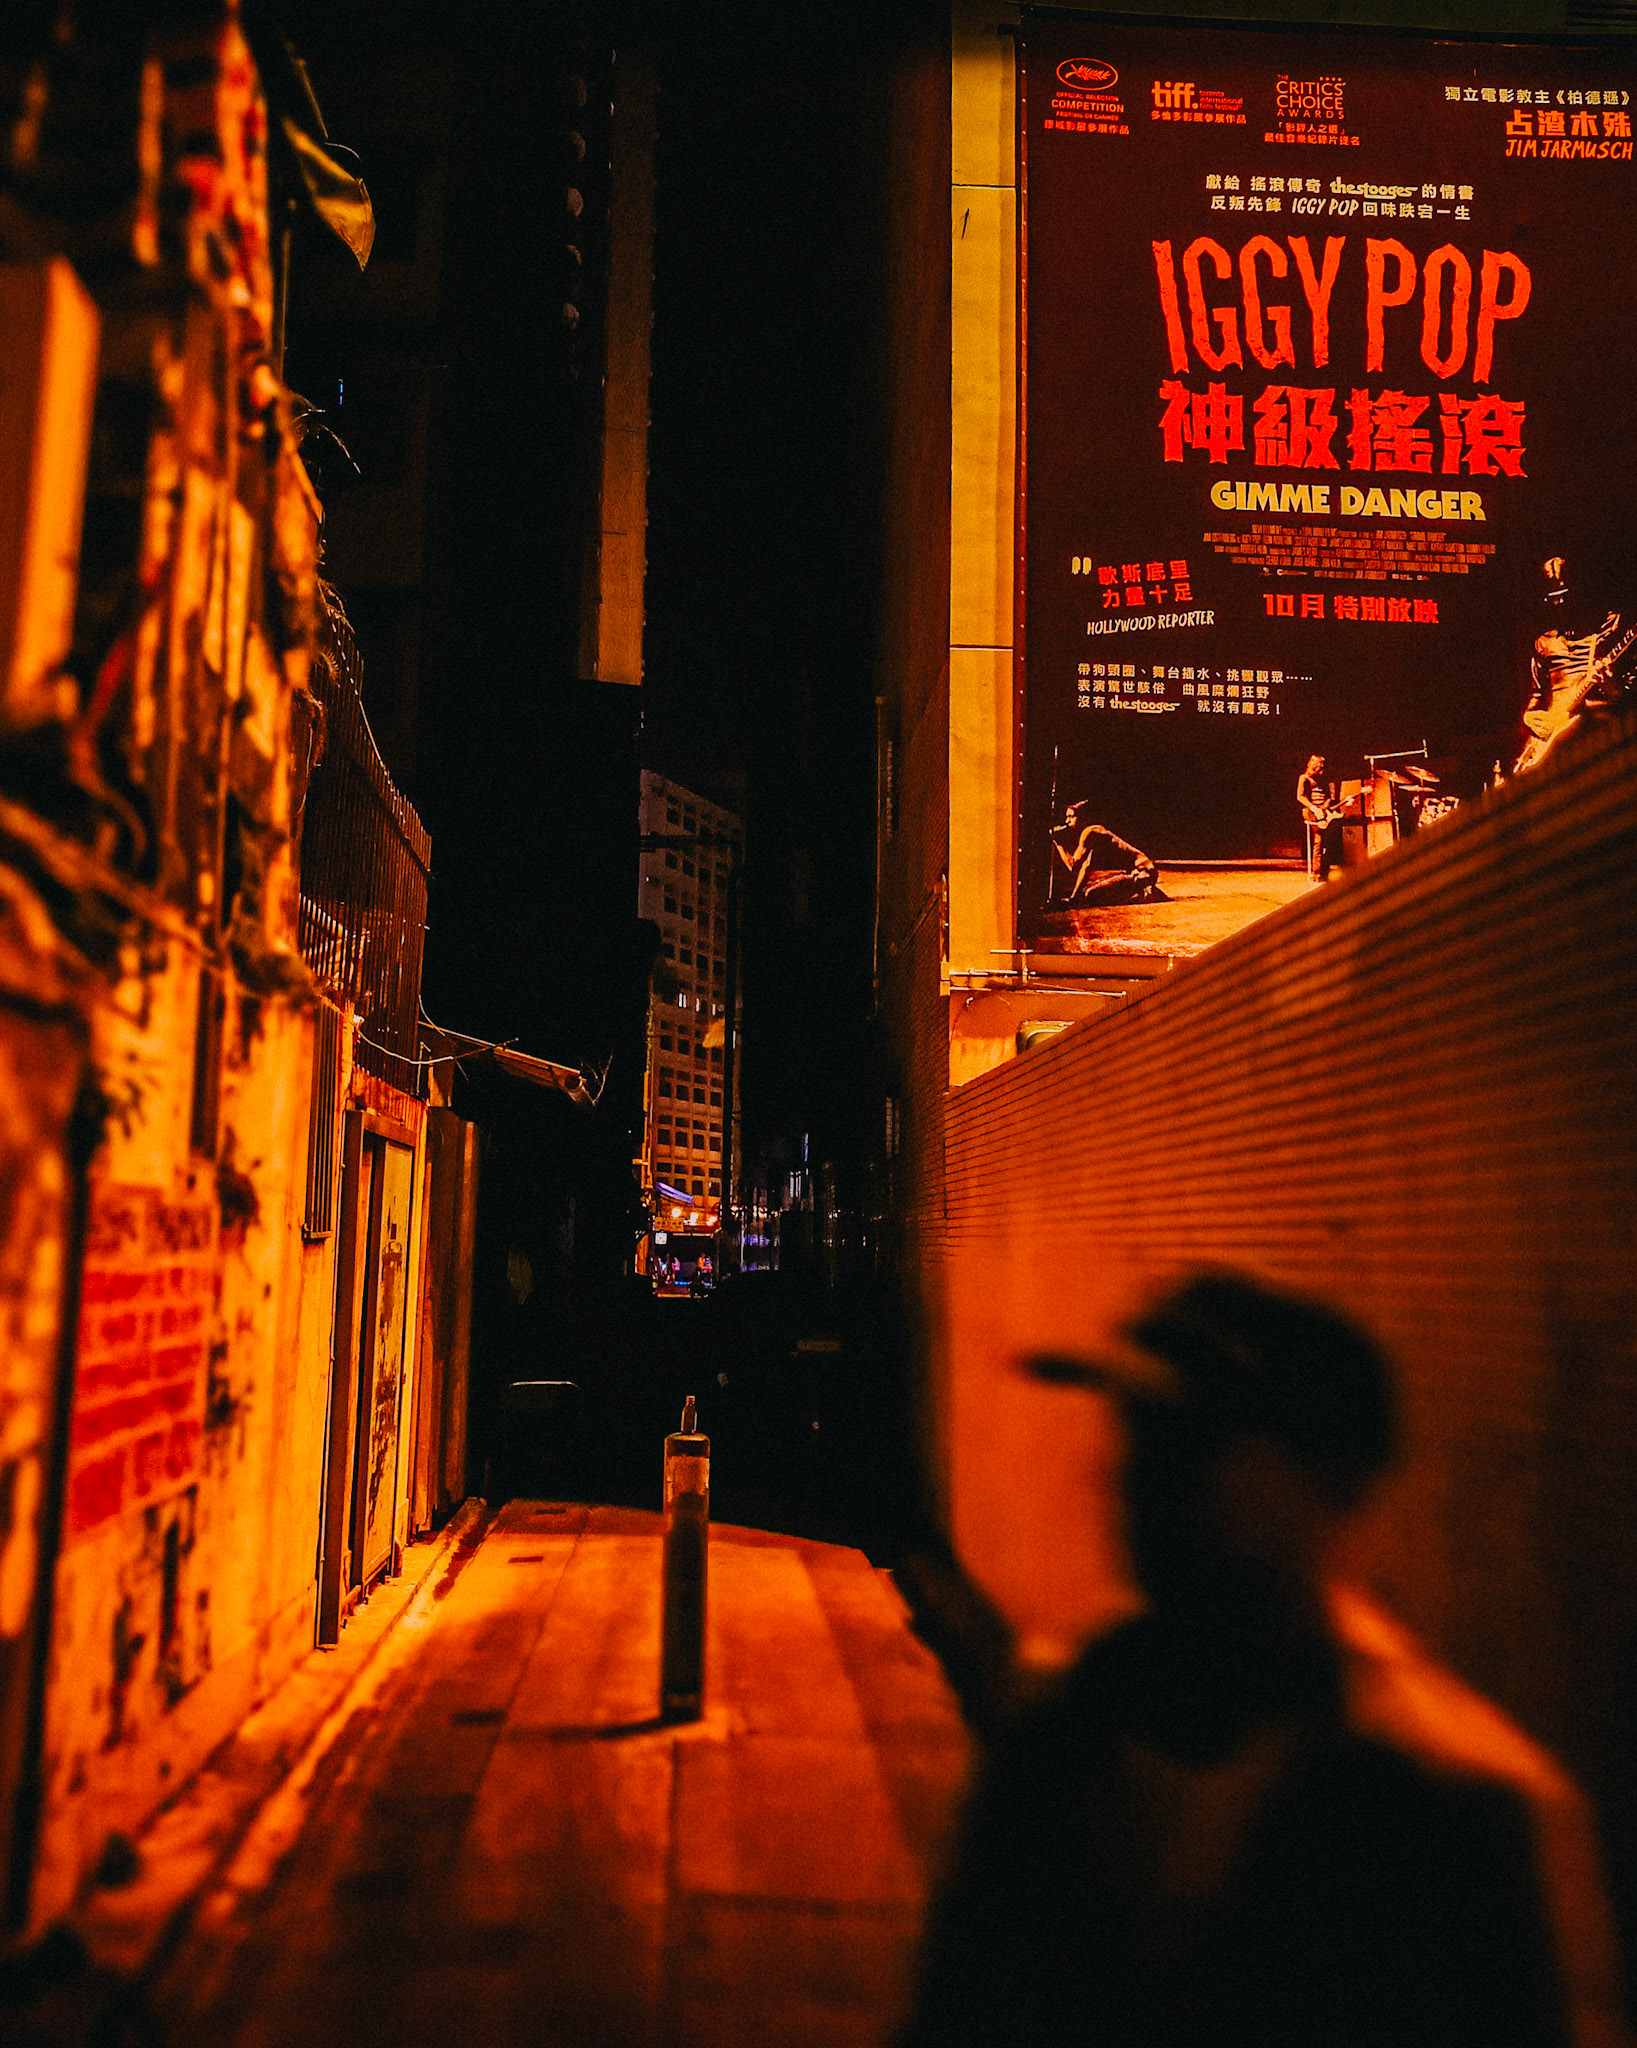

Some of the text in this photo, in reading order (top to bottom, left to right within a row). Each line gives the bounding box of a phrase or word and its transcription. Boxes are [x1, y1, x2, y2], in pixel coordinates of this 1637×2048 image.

[1051, 98, 1125, 113] COMPETITION
[1151, 80, 1199, 109] tiff.
[1276, 94, 1344, 111] CHOICE
[1276, 108, 1345, 120] AWARDS
[1505, 109, 1632, 137] 占渣木殊
[1505, 138, 1634, 161] JIM JARMUSCH
[1205, 173, 1241, 190] 獻給
[1250, 176, 1322, 193] 搖滾傳奇
[1421, 183, 1475, 200] 的情書
[1291, 197, 1327, 216] IGGY
[1328, 198, 1360, 216] POP
[1151, 234, 1533, 385] IGGY POP
[1157, 378, 1529, 479] 神級搖滾
[1209, 479, 1487, 522] GIMME DANGER
[1101, 582, 1194, 609] 力量十足
[1333, 594, 1440, 624] 特別放映
[1086, 610, 1216, 636] HOLLYWOOD REPORTER
